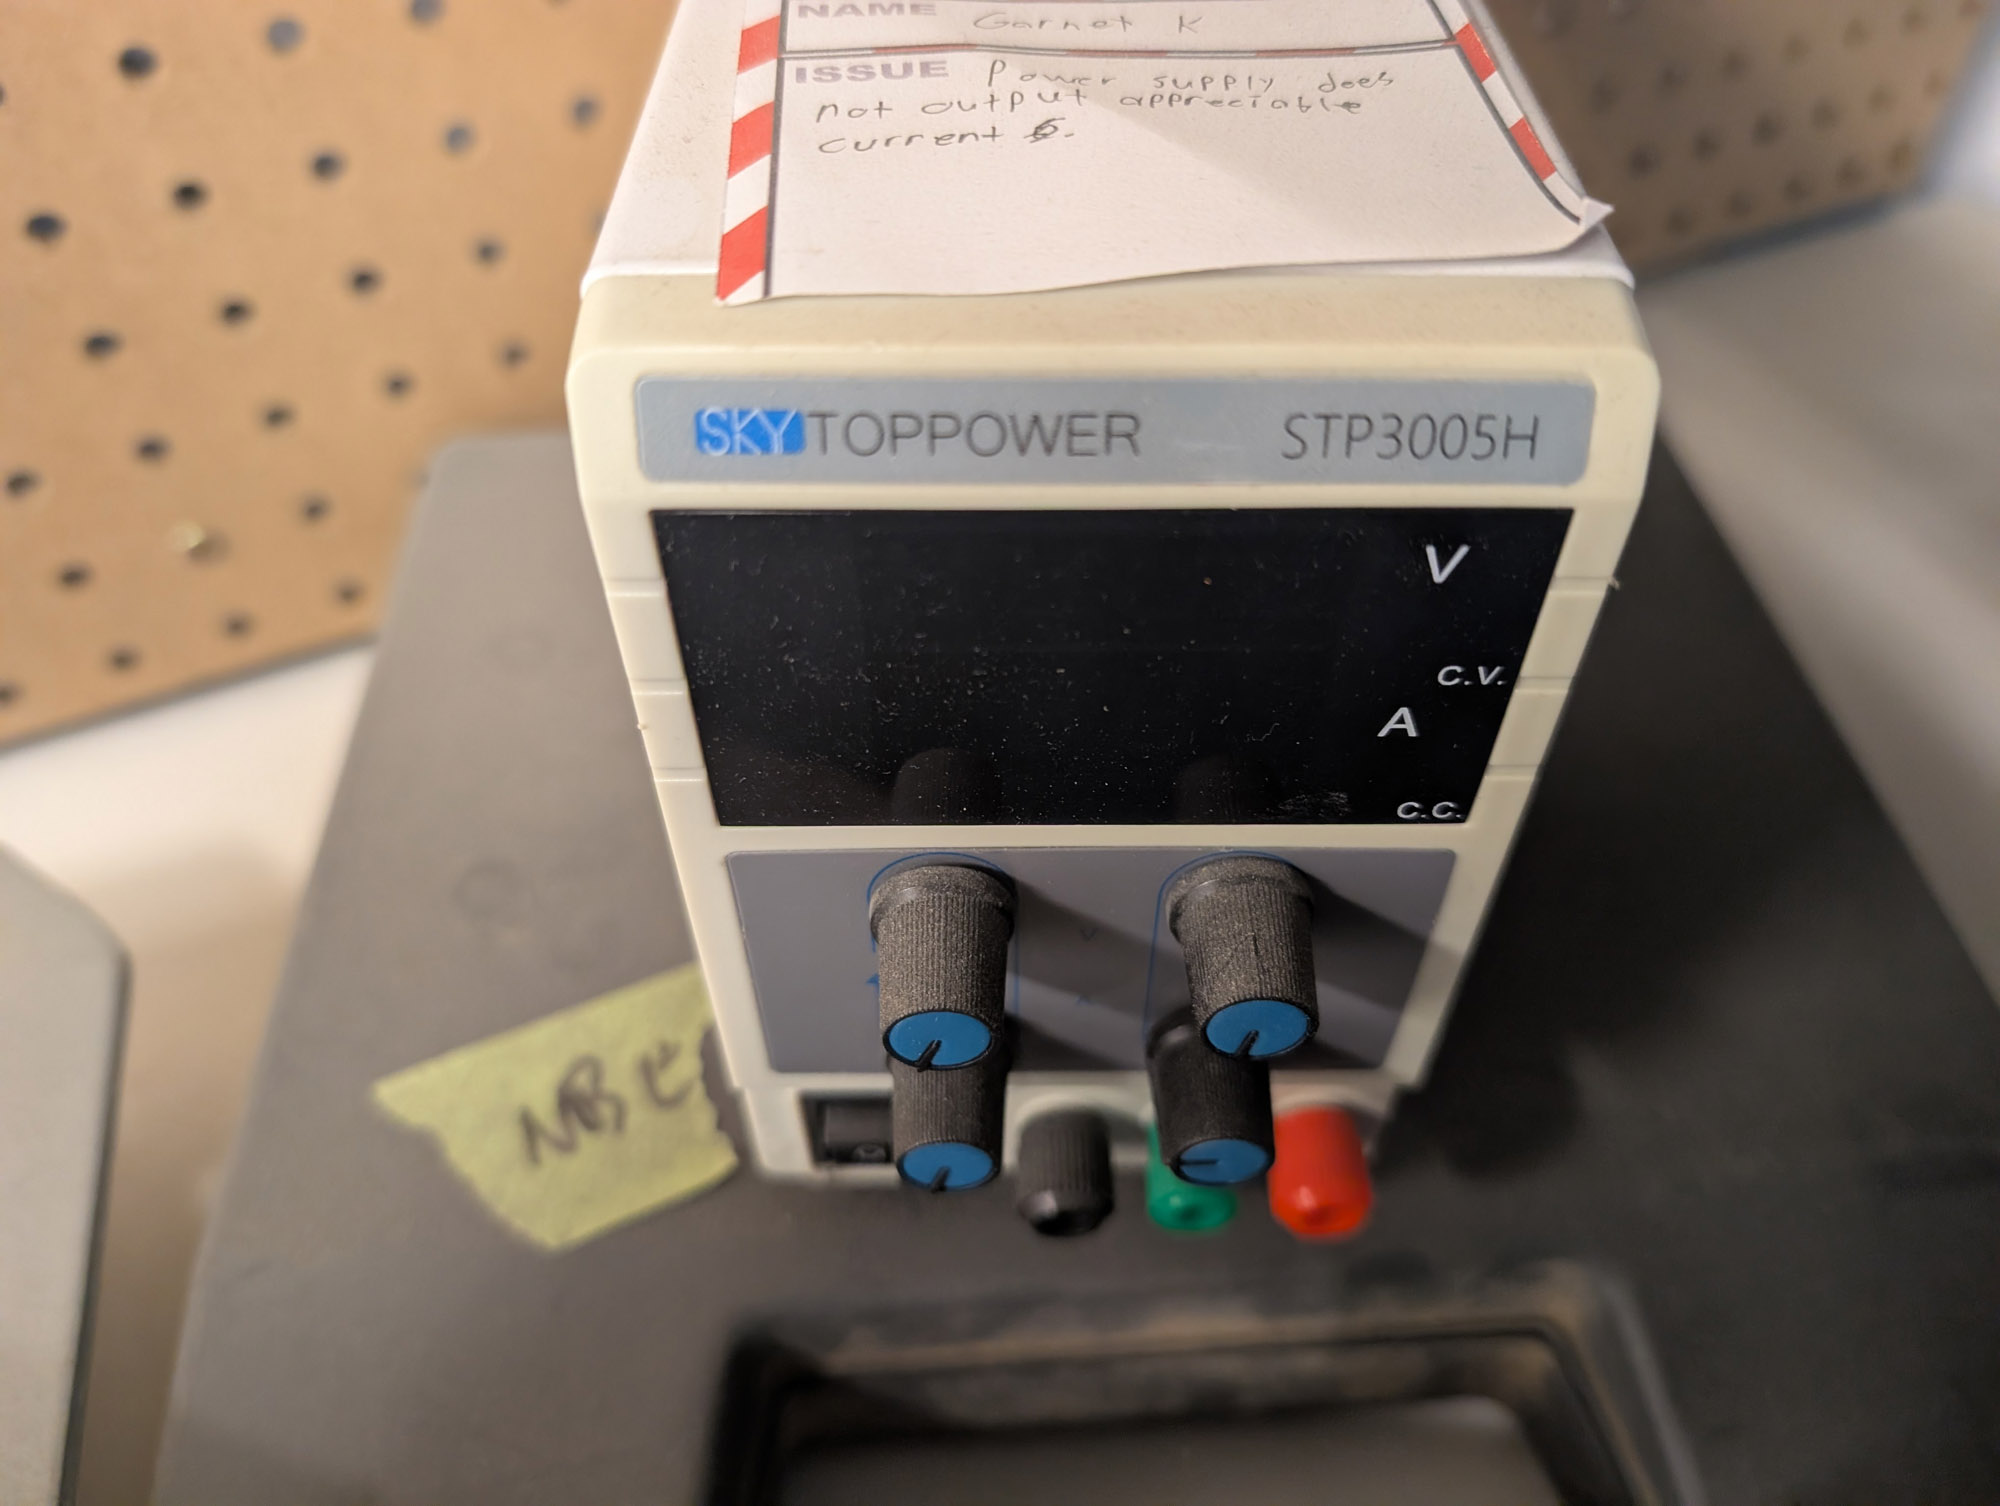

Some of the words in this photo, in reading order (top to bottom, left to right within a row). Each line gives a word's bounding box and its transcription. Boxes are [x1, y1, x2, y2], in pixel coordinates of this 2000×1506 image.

[798, 1, 938, 19] NAME
[795, 60, 950, 84] ISSUE
[987, 58, 1116, 88] Power
[815, 99, 893, 123] not
[920, 87, 1087, 115] output
[817, 125, 1003, 154] current
[1281, 412, 1540, 461] STP3005H
[1424, 543, 1471, 584] V
[1436, 664, 1507, 687] C.V.
[1376, 706, 1419, 738] A
[1396, 801, 1463, 820] C.C.
